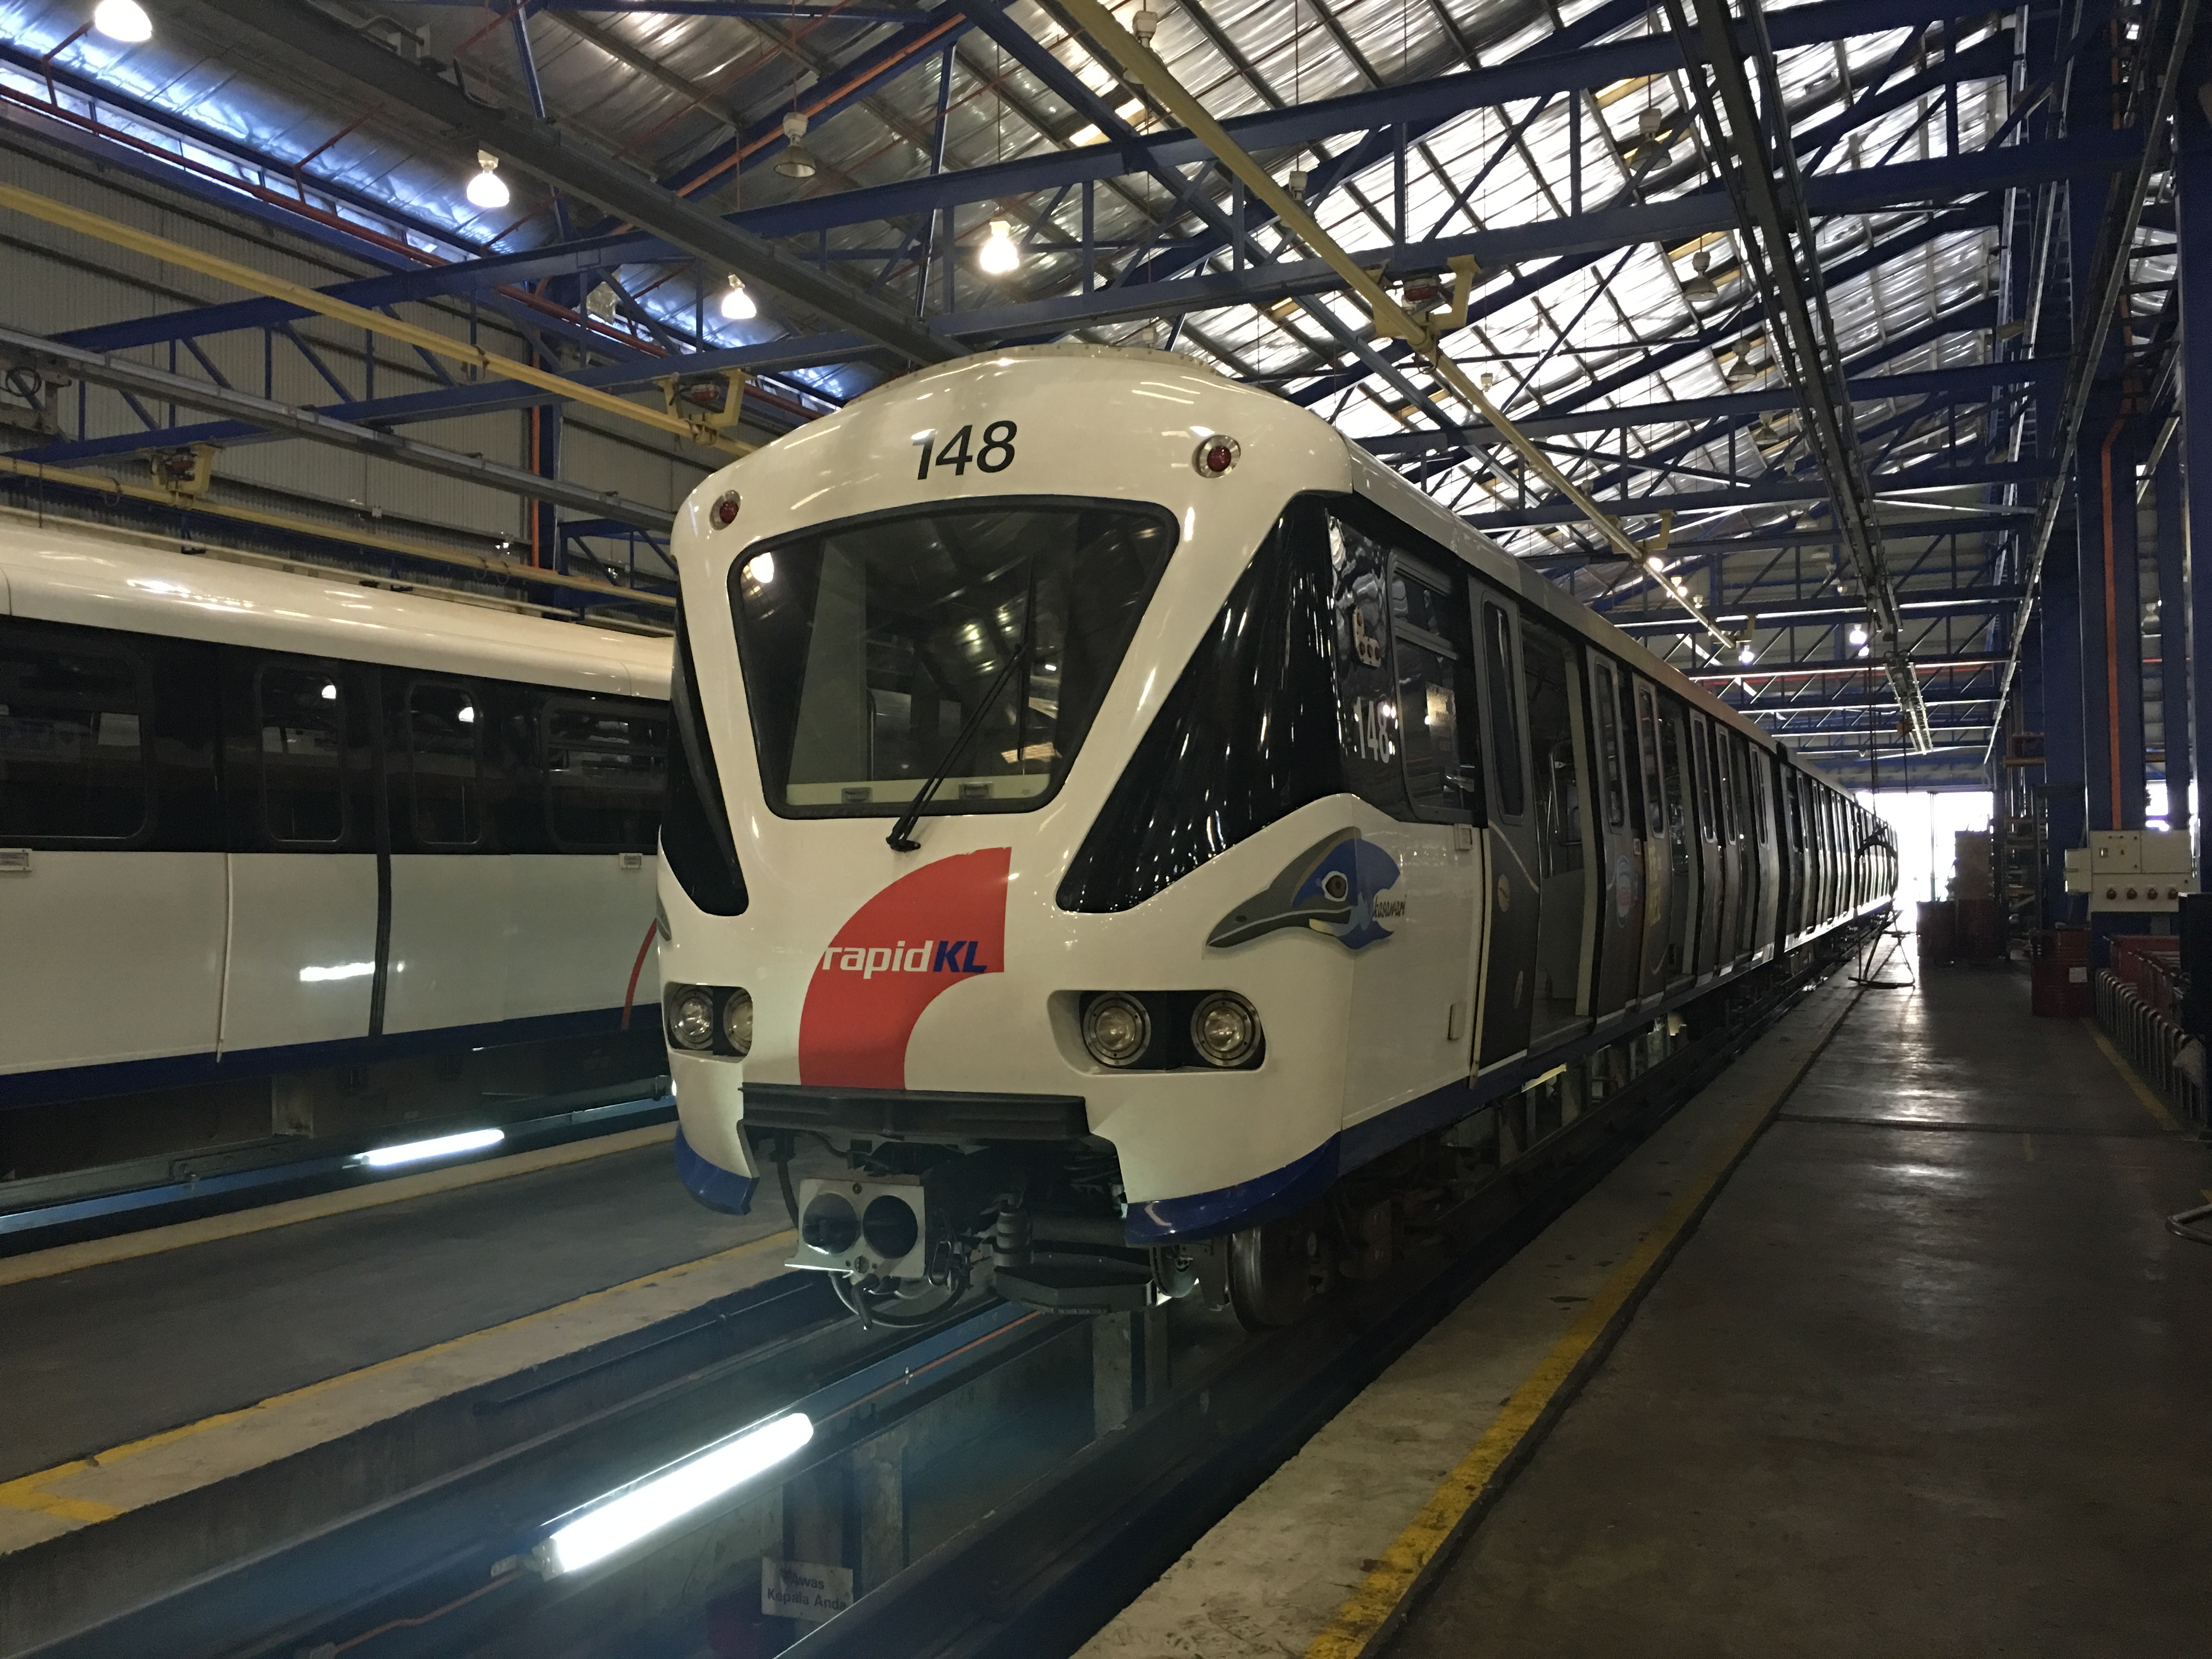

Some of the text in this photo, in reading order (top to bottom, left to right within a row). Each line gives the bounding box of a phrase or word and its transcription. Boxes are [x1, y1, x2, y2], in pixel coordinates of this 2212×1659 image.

[911, 420, 1017, 480] 148
[1353, 696, 1390, 764] 148
[822, 940, 987, 979] rapidKL
[768, 1588, 847, 1611] Kepala Anda
[791, 1572, 825, 1590] Awas
